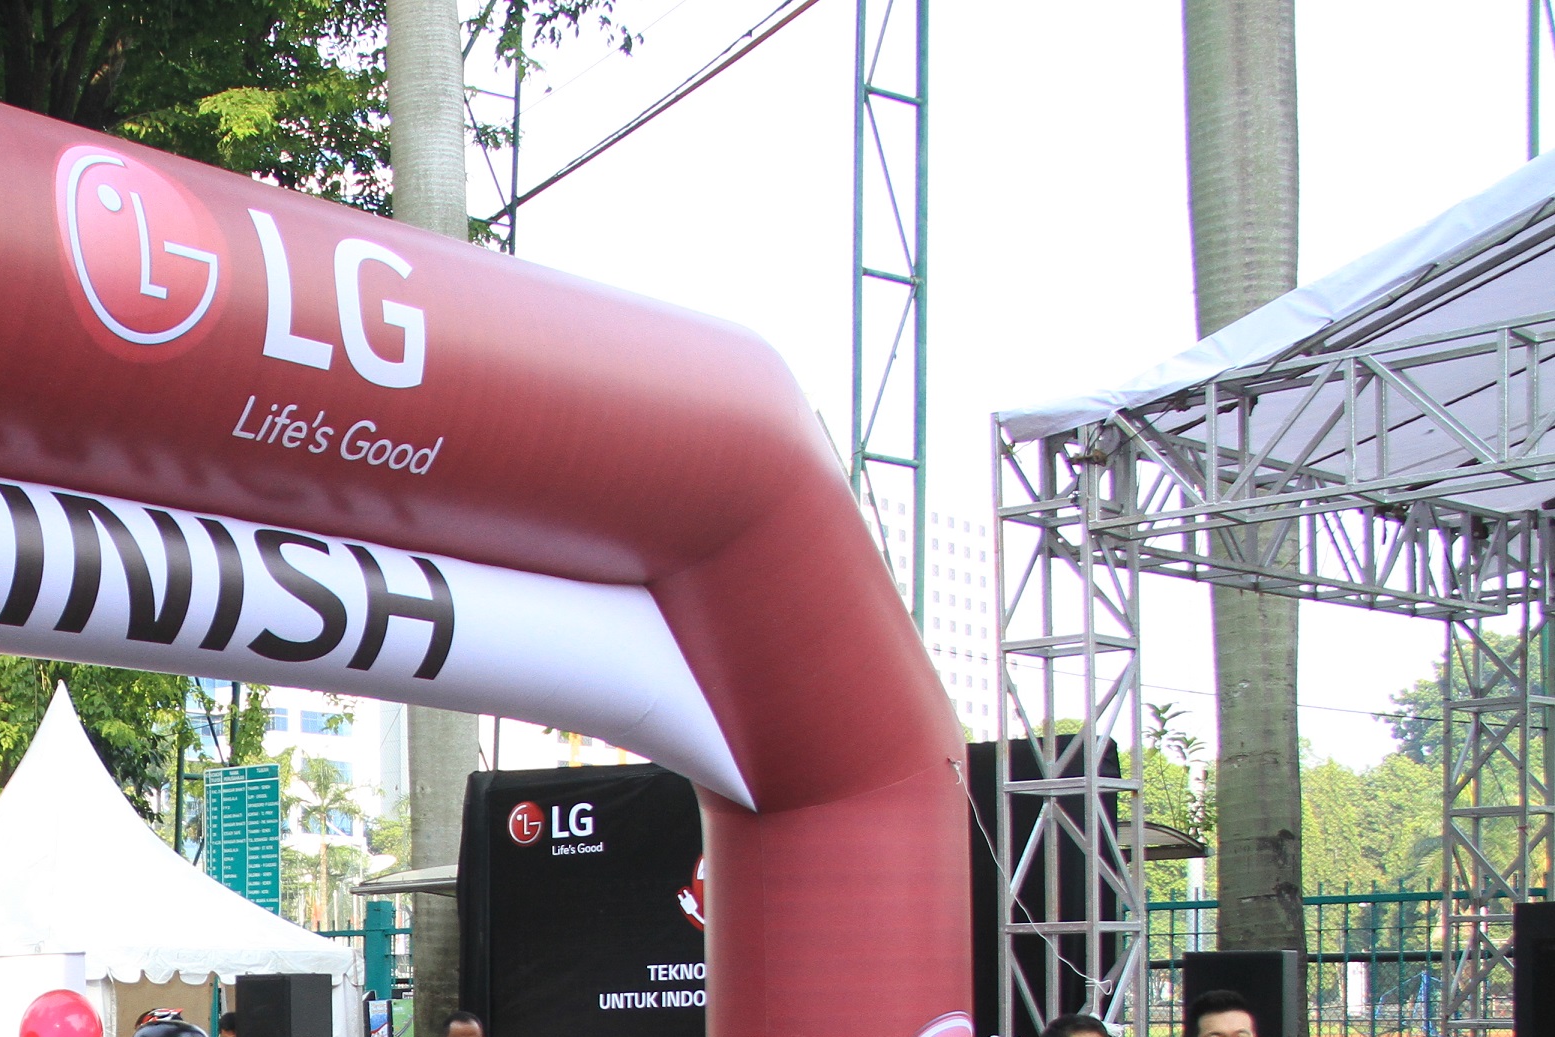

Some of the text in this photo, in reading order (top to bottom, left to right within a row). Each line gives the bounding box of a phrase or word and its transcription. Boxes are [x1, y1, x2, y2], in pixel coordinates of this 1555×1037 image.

[247, 208, 425, 389] LG
[232, 395, 445, 476] Life's Good
[551, 803, 594, 838] LG
[551, 842, 604, 856] Life's Good
[647, 963, 706, 981] TEKNO
[599, 990, 706, 1009] UNTUK INDO
